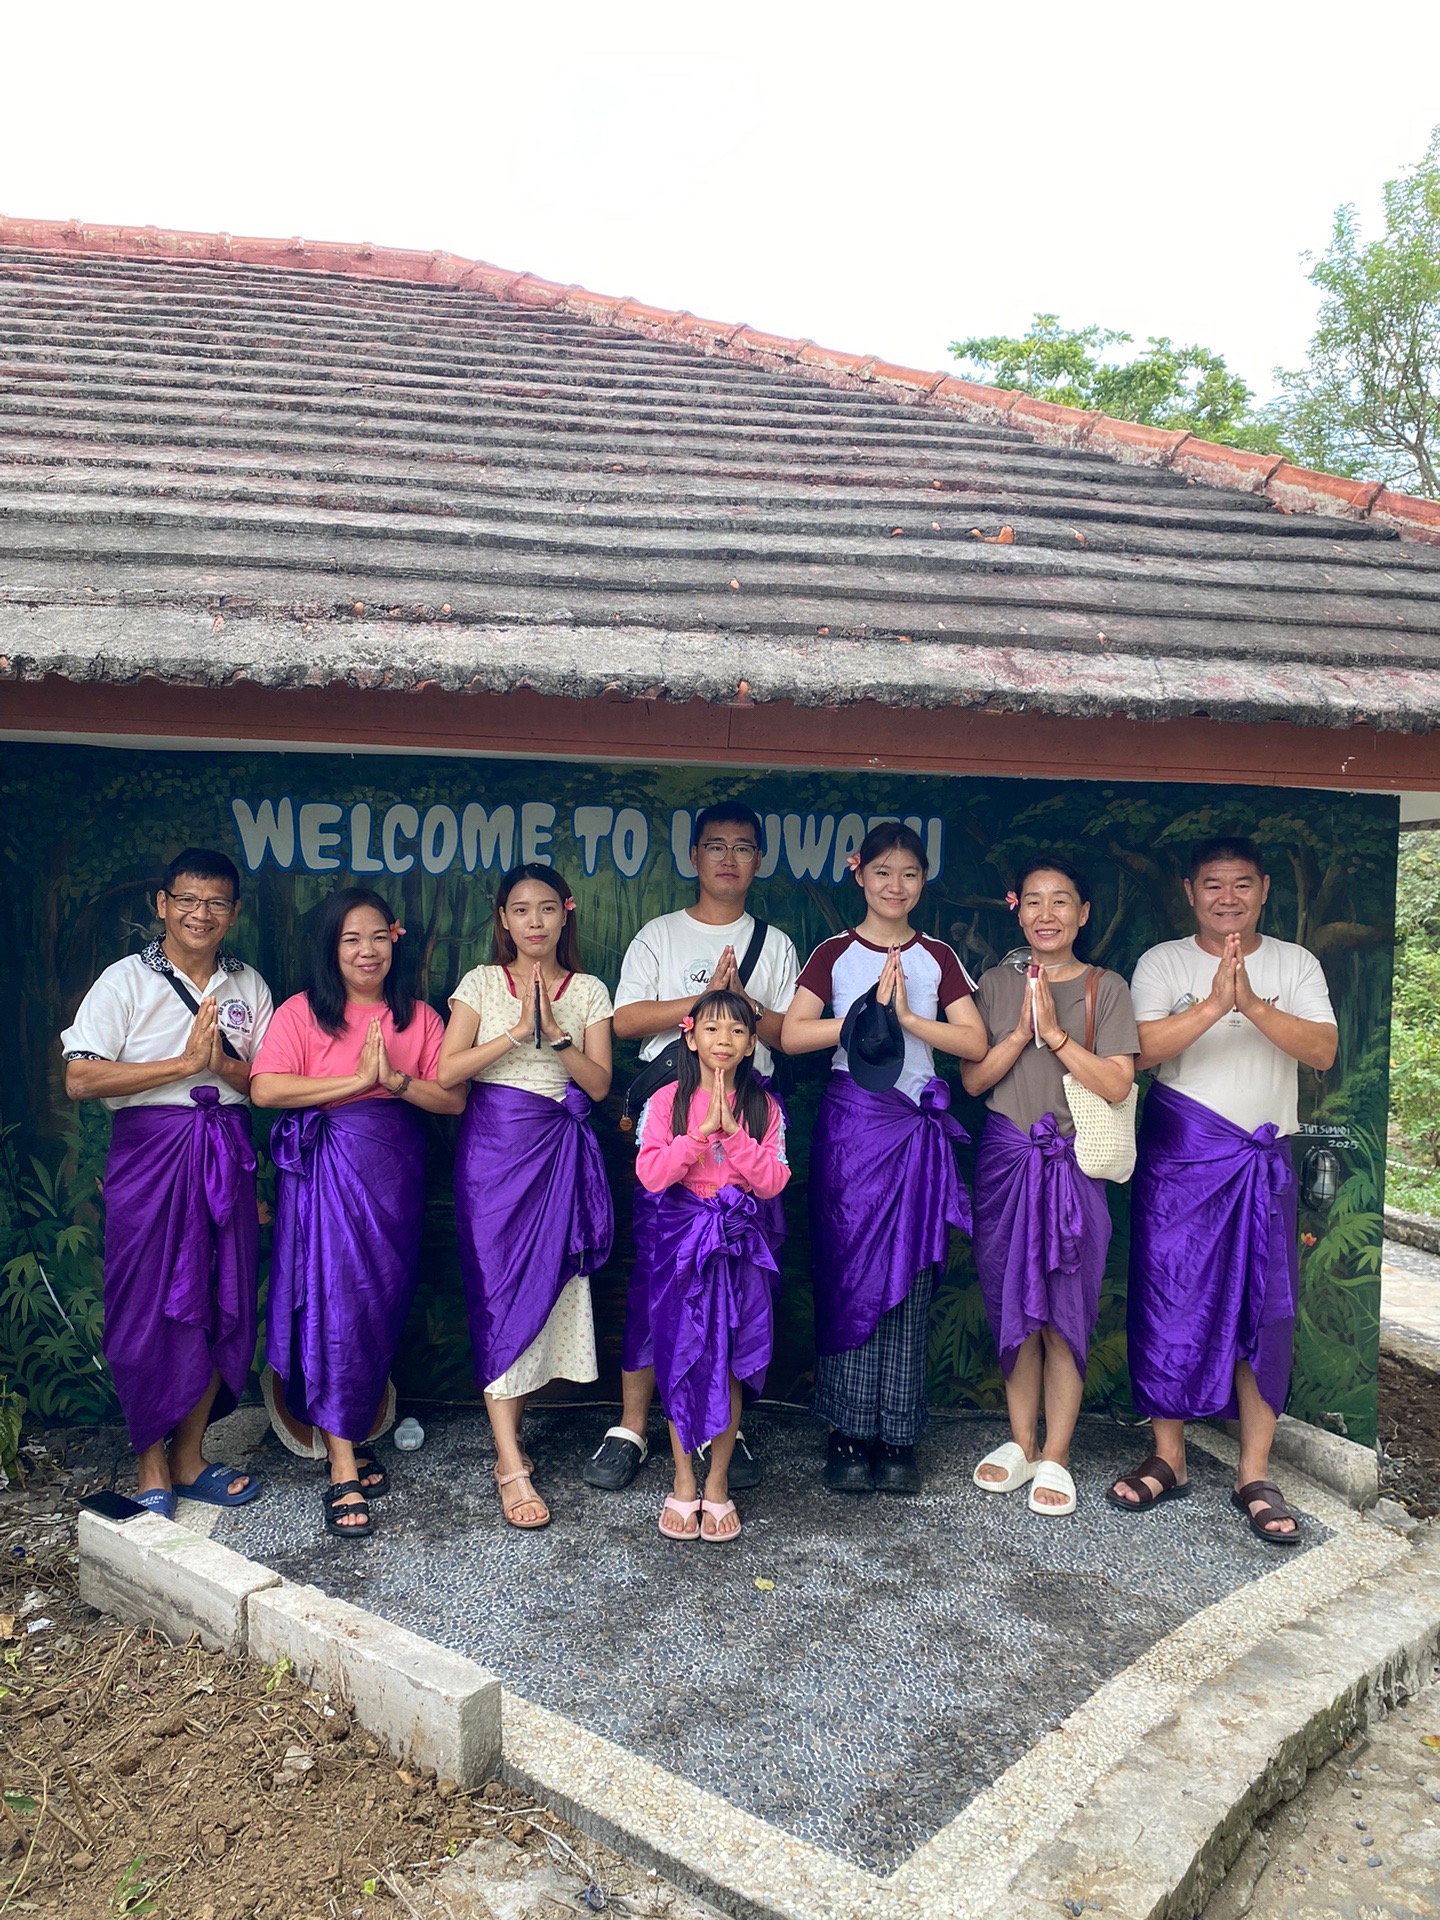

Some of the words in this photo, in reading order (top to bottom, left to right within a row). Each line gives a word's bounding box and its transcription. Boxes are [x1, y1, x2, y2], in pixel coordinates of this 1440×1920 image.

[231, 796, 557, 874] WELCOME
[573, 805, 648, 878] TO
[1327, 1139, 1360, 1150] 2025
